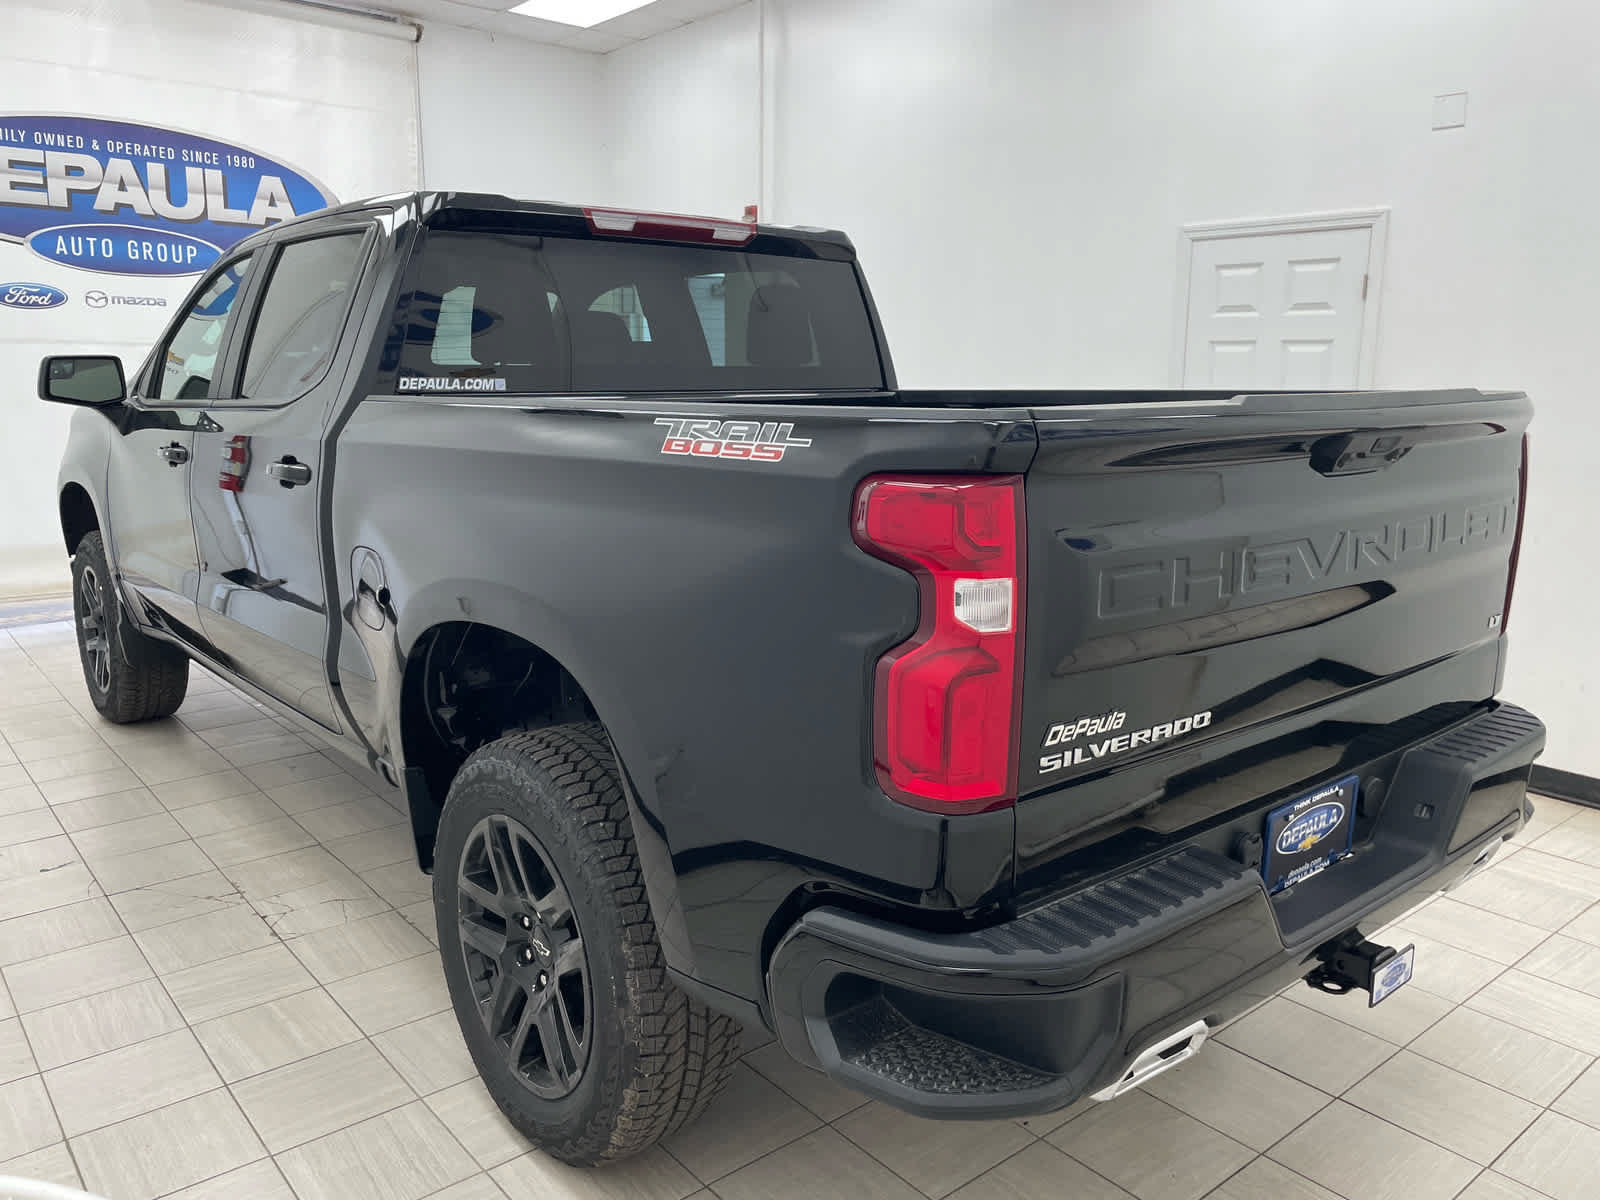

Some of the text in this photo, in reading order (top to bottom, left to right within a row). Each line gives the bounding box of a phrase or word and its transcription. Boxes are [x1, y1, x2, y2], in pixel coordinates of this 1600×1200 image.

[0, 128, 255, 169] ILY OWNED & OPERATED SINCE 1980
[55, 235, 197, 264] AUTO GROUP
[4, 286, 53, 305] Ford
[111, 295, 168, 307] mazda
[400, 378, 494, 390] DEPAULA.COM
[654, 418, 812, 447] TRAIL
[661, 438, 787, 462] BOSS
[1098, 497, 1514, 619] CHEVROLET
[1039, 711, 1212, 774] SILVERADO
[1045, 711, 1126, 746] DePaula
[1282, 808, 1338, 849] DEPAULA
